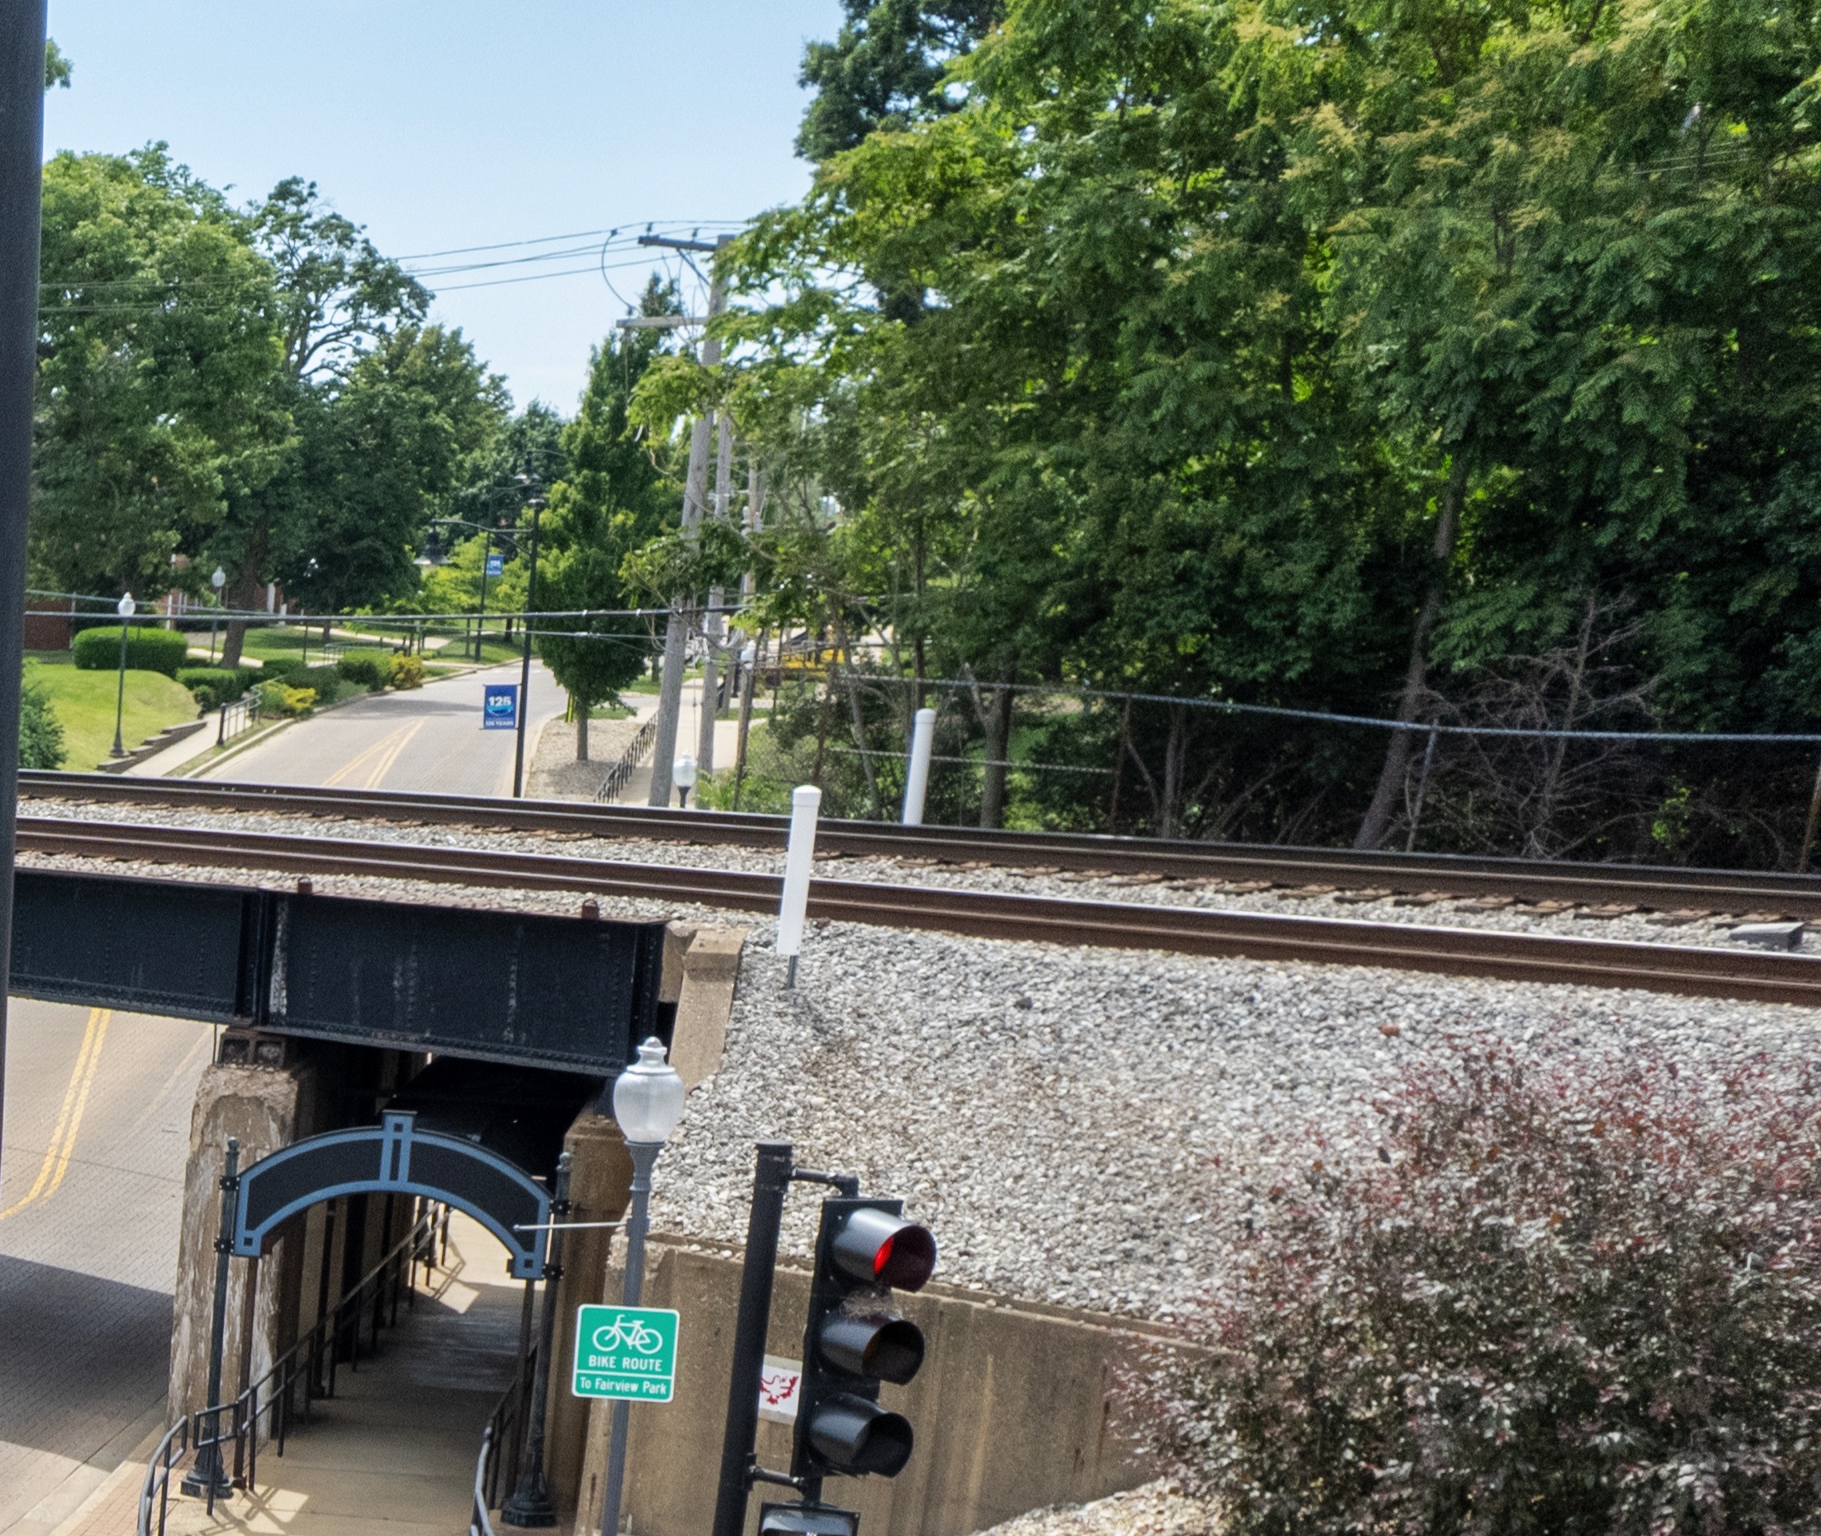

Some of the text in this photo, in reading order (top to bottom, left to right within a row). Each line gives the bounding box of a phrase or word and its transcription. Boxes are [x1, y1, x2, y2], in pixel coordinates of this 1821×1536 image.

[588, 1355, 663, 1372] BIKE ROUTE
[580, 1376, 667, 1395] To Fairview Park
